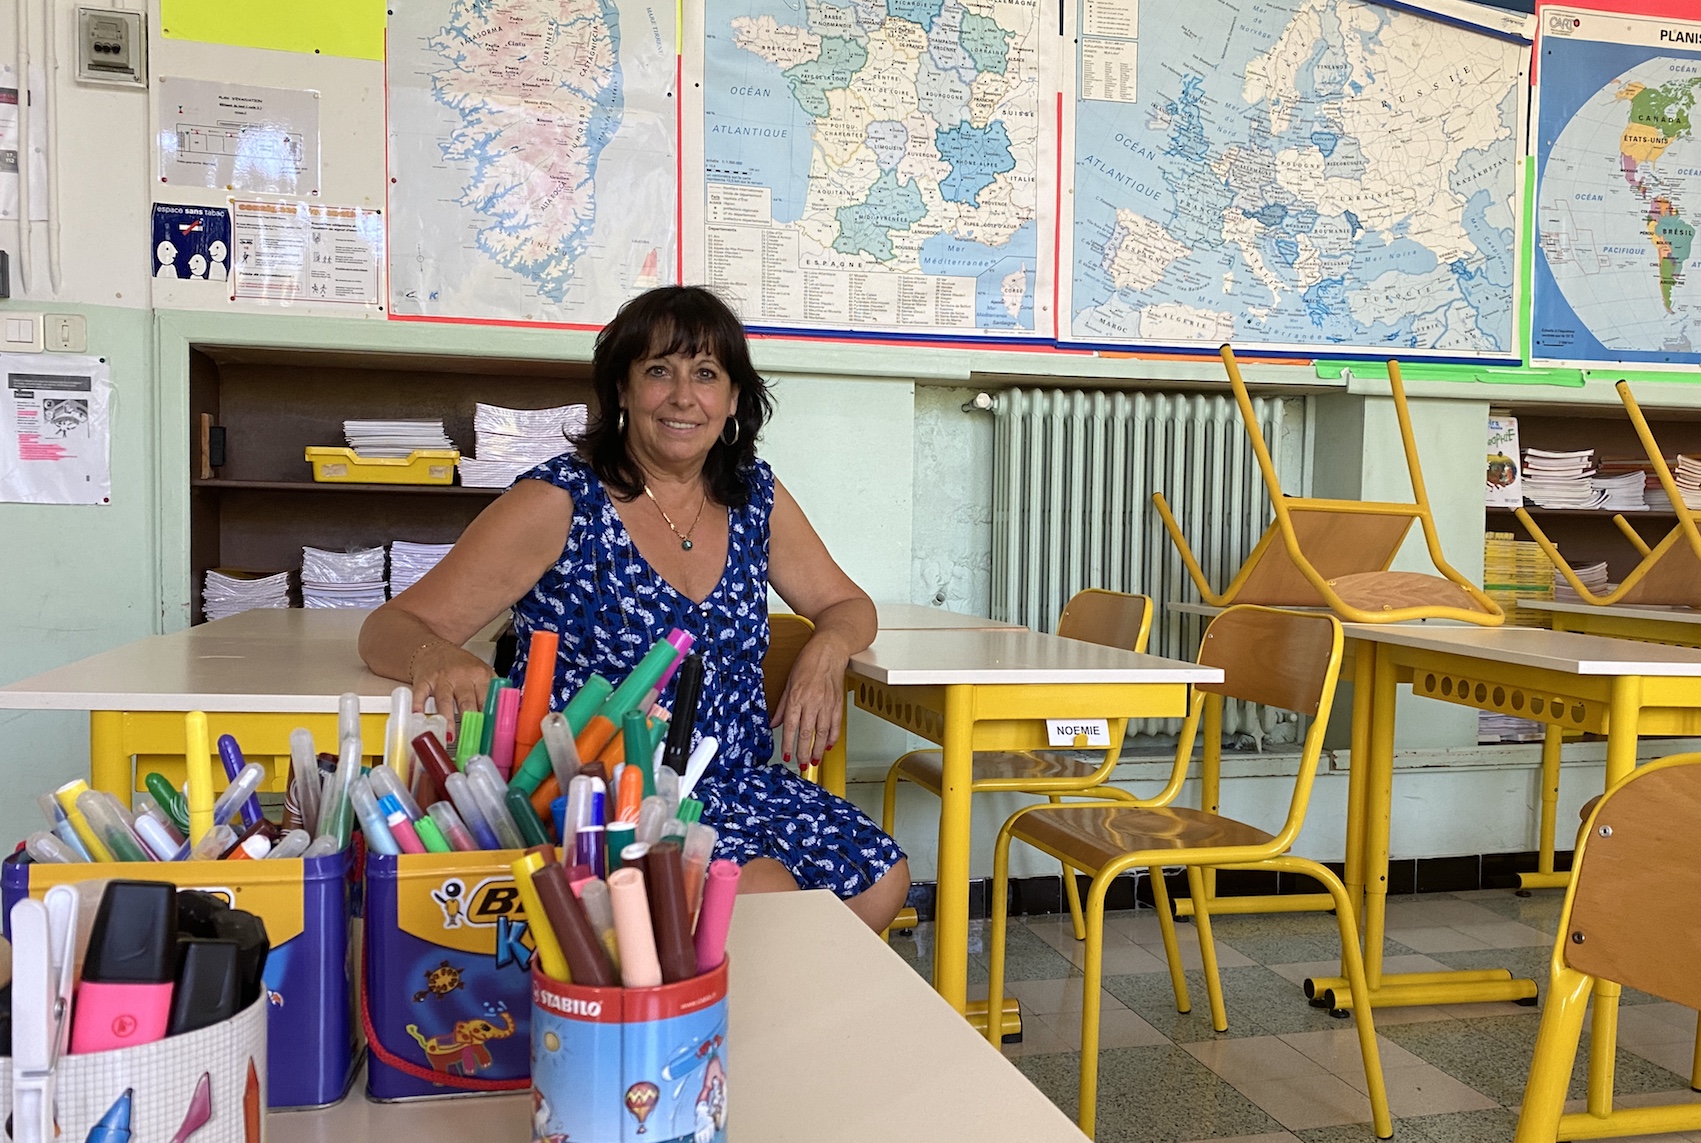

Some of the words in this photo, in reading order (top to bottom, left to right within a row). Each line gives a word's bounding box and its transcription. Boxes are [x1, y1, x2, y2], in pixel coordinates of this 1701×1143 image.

[1253, 5, 1267, 14] Mer
[1253, 17, 1262, 25] de
[1239, 24, 1272, 40] Norvège
[761, 45, 802, 53] BRETAGNE
[971, 47, 1003, 56] LORRAINE
[1669, 64, 1698, 74] OCÉAN
[730, 86, 772, 98] OCÉAN
[1381, 66, 1471, 109] RUSSIE
[926, 91, 963, 100] BOURGOGNE
[1225, 102, 1240, 112] Mer
[1002, 109, 1035, 118] SUISSE
[1638, 114, 1682, 124] CANADA
[712, 124, 788, 139] ATLANTIQUE
[824, 131, 864, 139] CHARENTES
[1216, 126, 1237, 137] Nord
[1624, 134, 1669, 145] ÉTATS-UNIS
[1114, 132, 1157, 162] OCÉAN
[907, 151, 938, 159] AUVERGNE
[1281, 160, 1321, 169] POLOGNE
[1456, 157, 1508, 187] KAZAKHSTAN
[1084, 154, 1163, 202] ATLANTIQUE
[1339, 191, 1391, 202] UKRAINE
[1574, 192, 1604, 202] OCÉAN
[157, 206, 183, 214] espace
[184, 208, 204, 216] sans
[1179, 199, 1218, 220] FRANCE
[1662, 227, 1693, 237] BRÉSIL
[1470, 217, 1481, 232] Mer
[1483, 236, 1508, 275] Caspienne
[1603, 246, 1646, 256] PACIFIQUE
[1125, 244, 1166, 266] ESPAGNE
[1365, 255, 1383, 263] Mer
[1389, 249, 1417, 260] Noire
[806, 259, 862, 269] ESPAGNE
[924, 257, 990, 267] Méditerranée
[1197, 295, 1220, 307] Mer
[1099, 317, 1129, 334] MAROC
[1239, 311, 1323, 340] Mditerranée
[1056, 725, 1101, 736] NOEMIE
[540, 989, 603, 1018] STABILO
